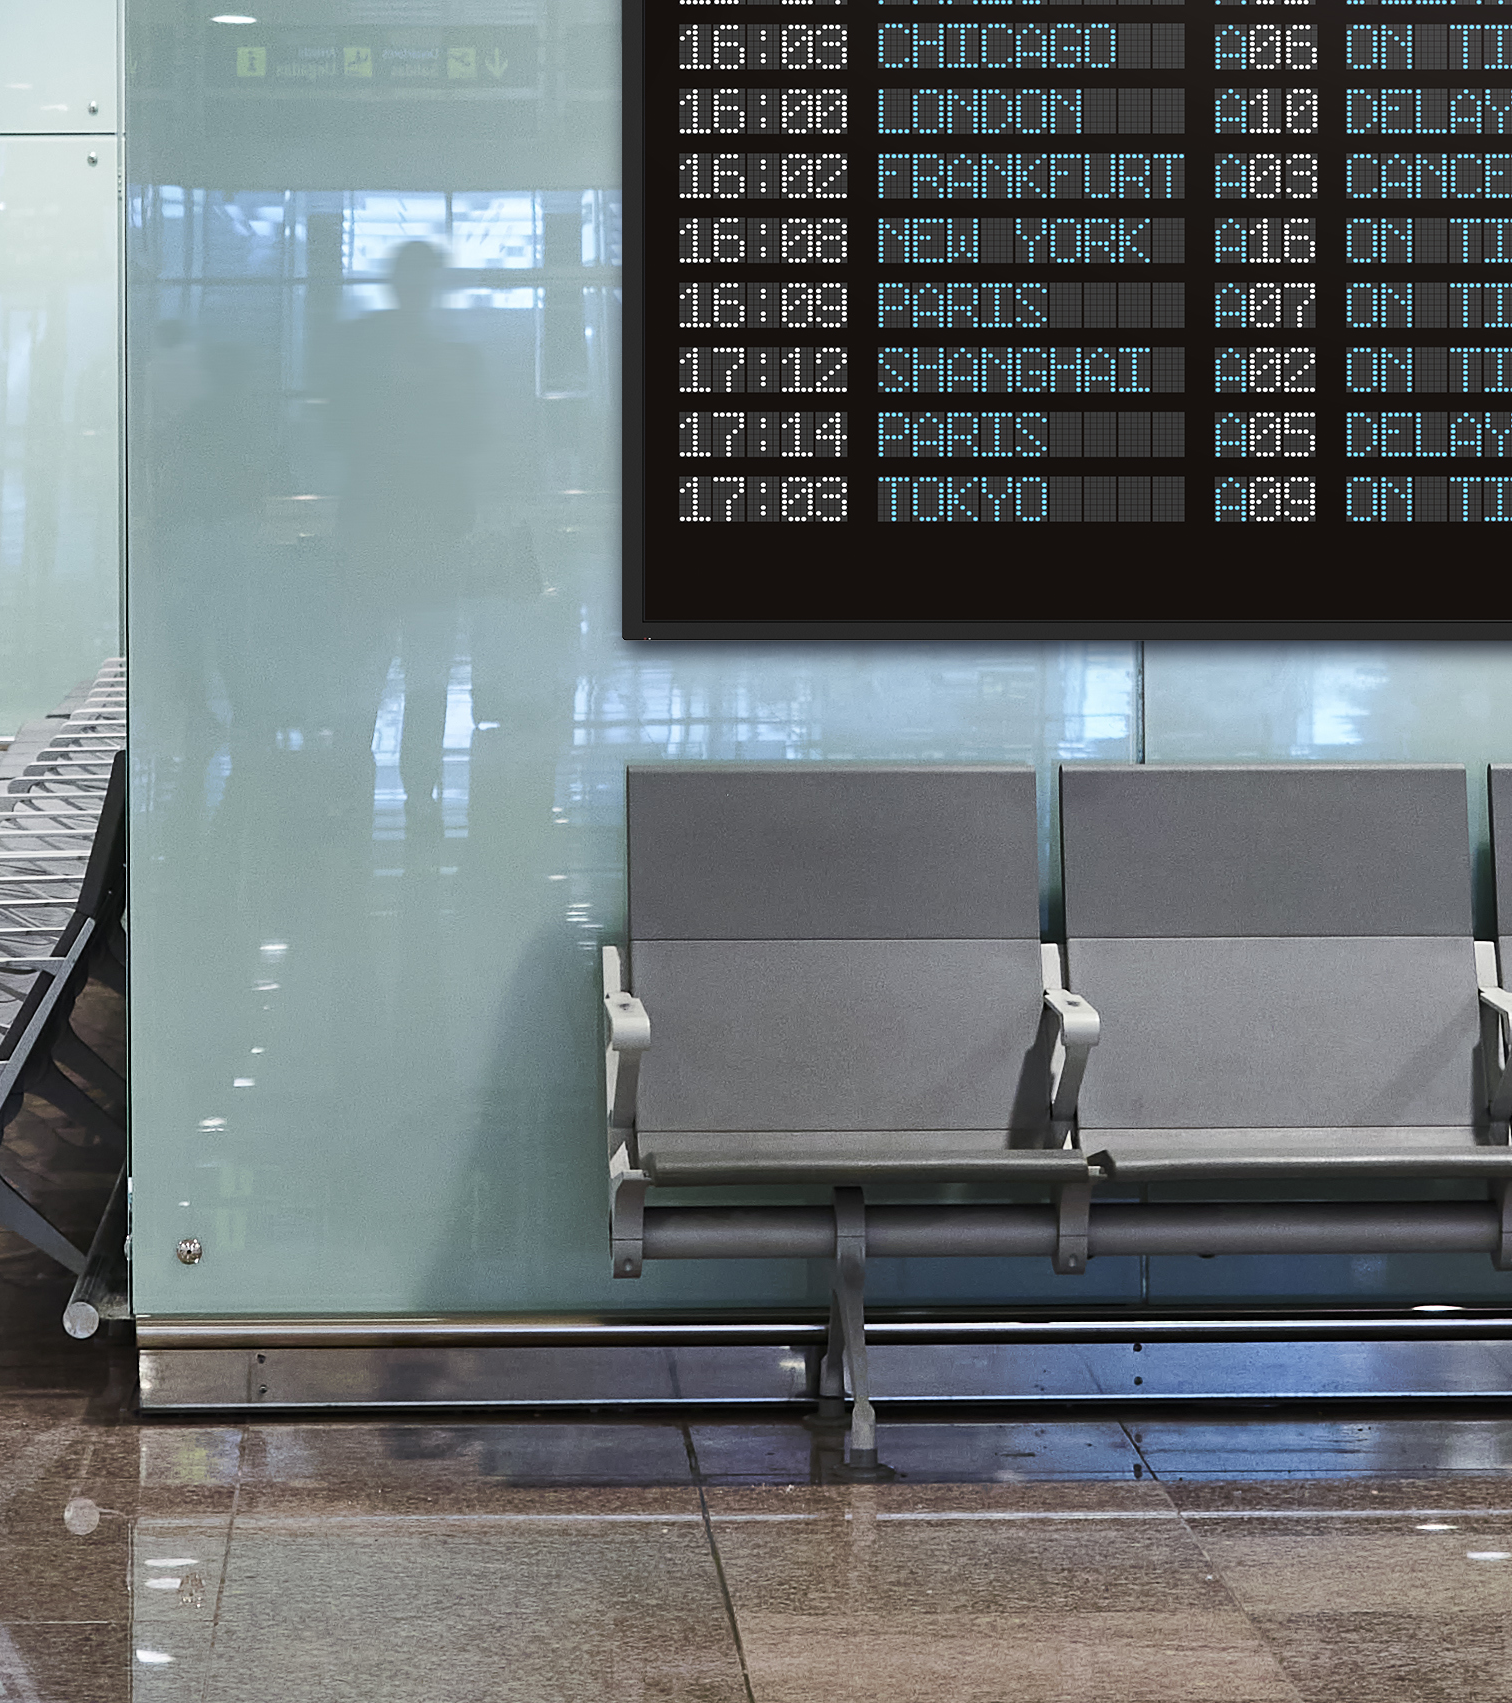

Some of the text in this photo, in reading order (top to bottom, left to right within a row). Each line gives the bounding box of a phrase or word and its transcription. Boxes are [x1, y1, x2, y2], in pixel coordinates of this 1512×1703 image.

[680, 89, 847, 133] 16:00
[879, 90, 1081, 133] LONDON
[1216, 89, 1317, 133] A10
[680, 218, 847, 263] 16:08
[879, 219, 978, 262] NEW
[1016, 219, 1150, 262] YORK
[1216, 219, 1315, 263] A16
[1347, 219, 1412, 262] ON
[680, 348, 847, 392] 17:12
[879, 348, 1150, 392] SHANGHAI
[1216, 348, 1315, 392] A02
[1347, 348, 1412, 392] ON
[680, 477, 847, 521] 17:03
[879, 477, 1047, 521] TOKYO
[1216, 477, 1315, 521] A09
[1347, 477, 1412, 521] ON
